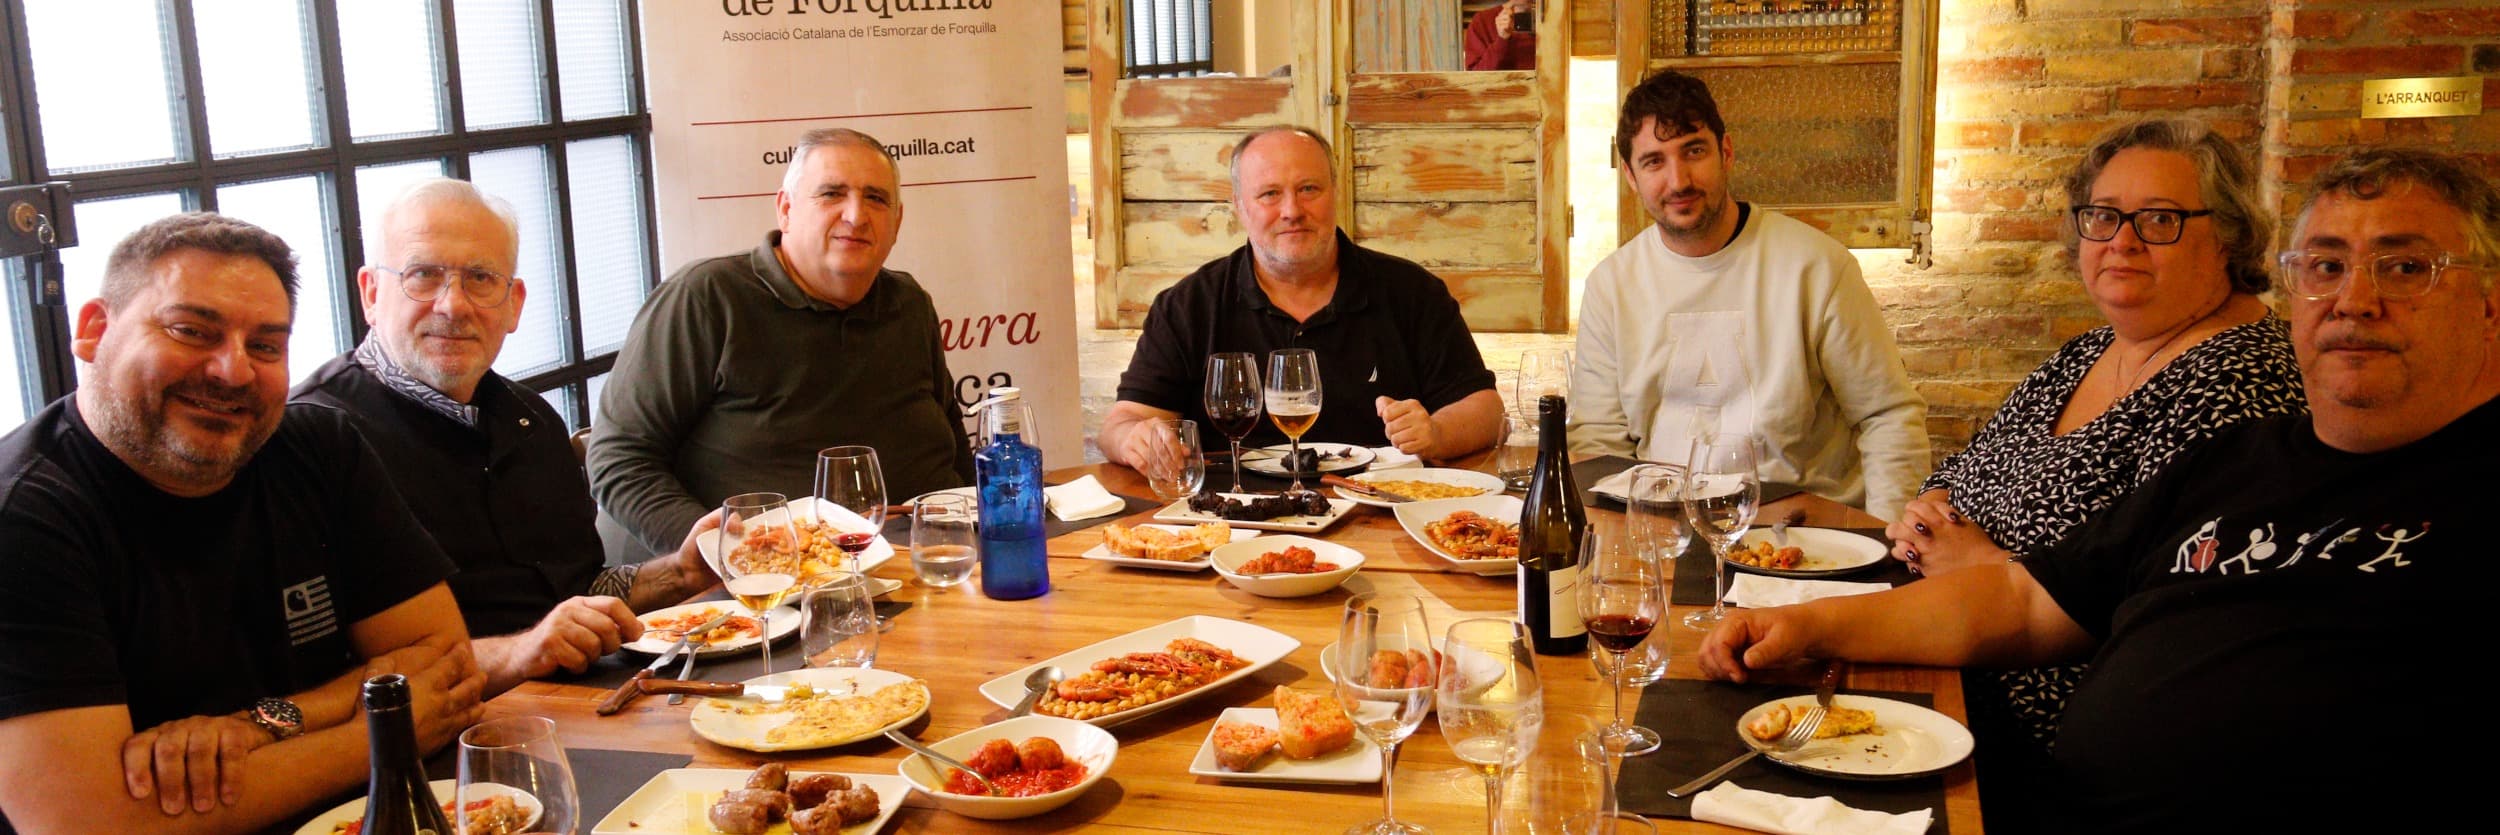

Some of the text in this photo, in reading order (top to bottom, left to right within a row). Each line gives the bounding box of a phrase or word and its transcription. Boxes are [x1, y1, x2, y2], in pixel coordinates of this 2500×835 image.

[722, 21, 997, 41] Associació Catalana de l'Esmorzar de Forquilla
[2376, 91, 2468, 104] L'ARRANQUET
